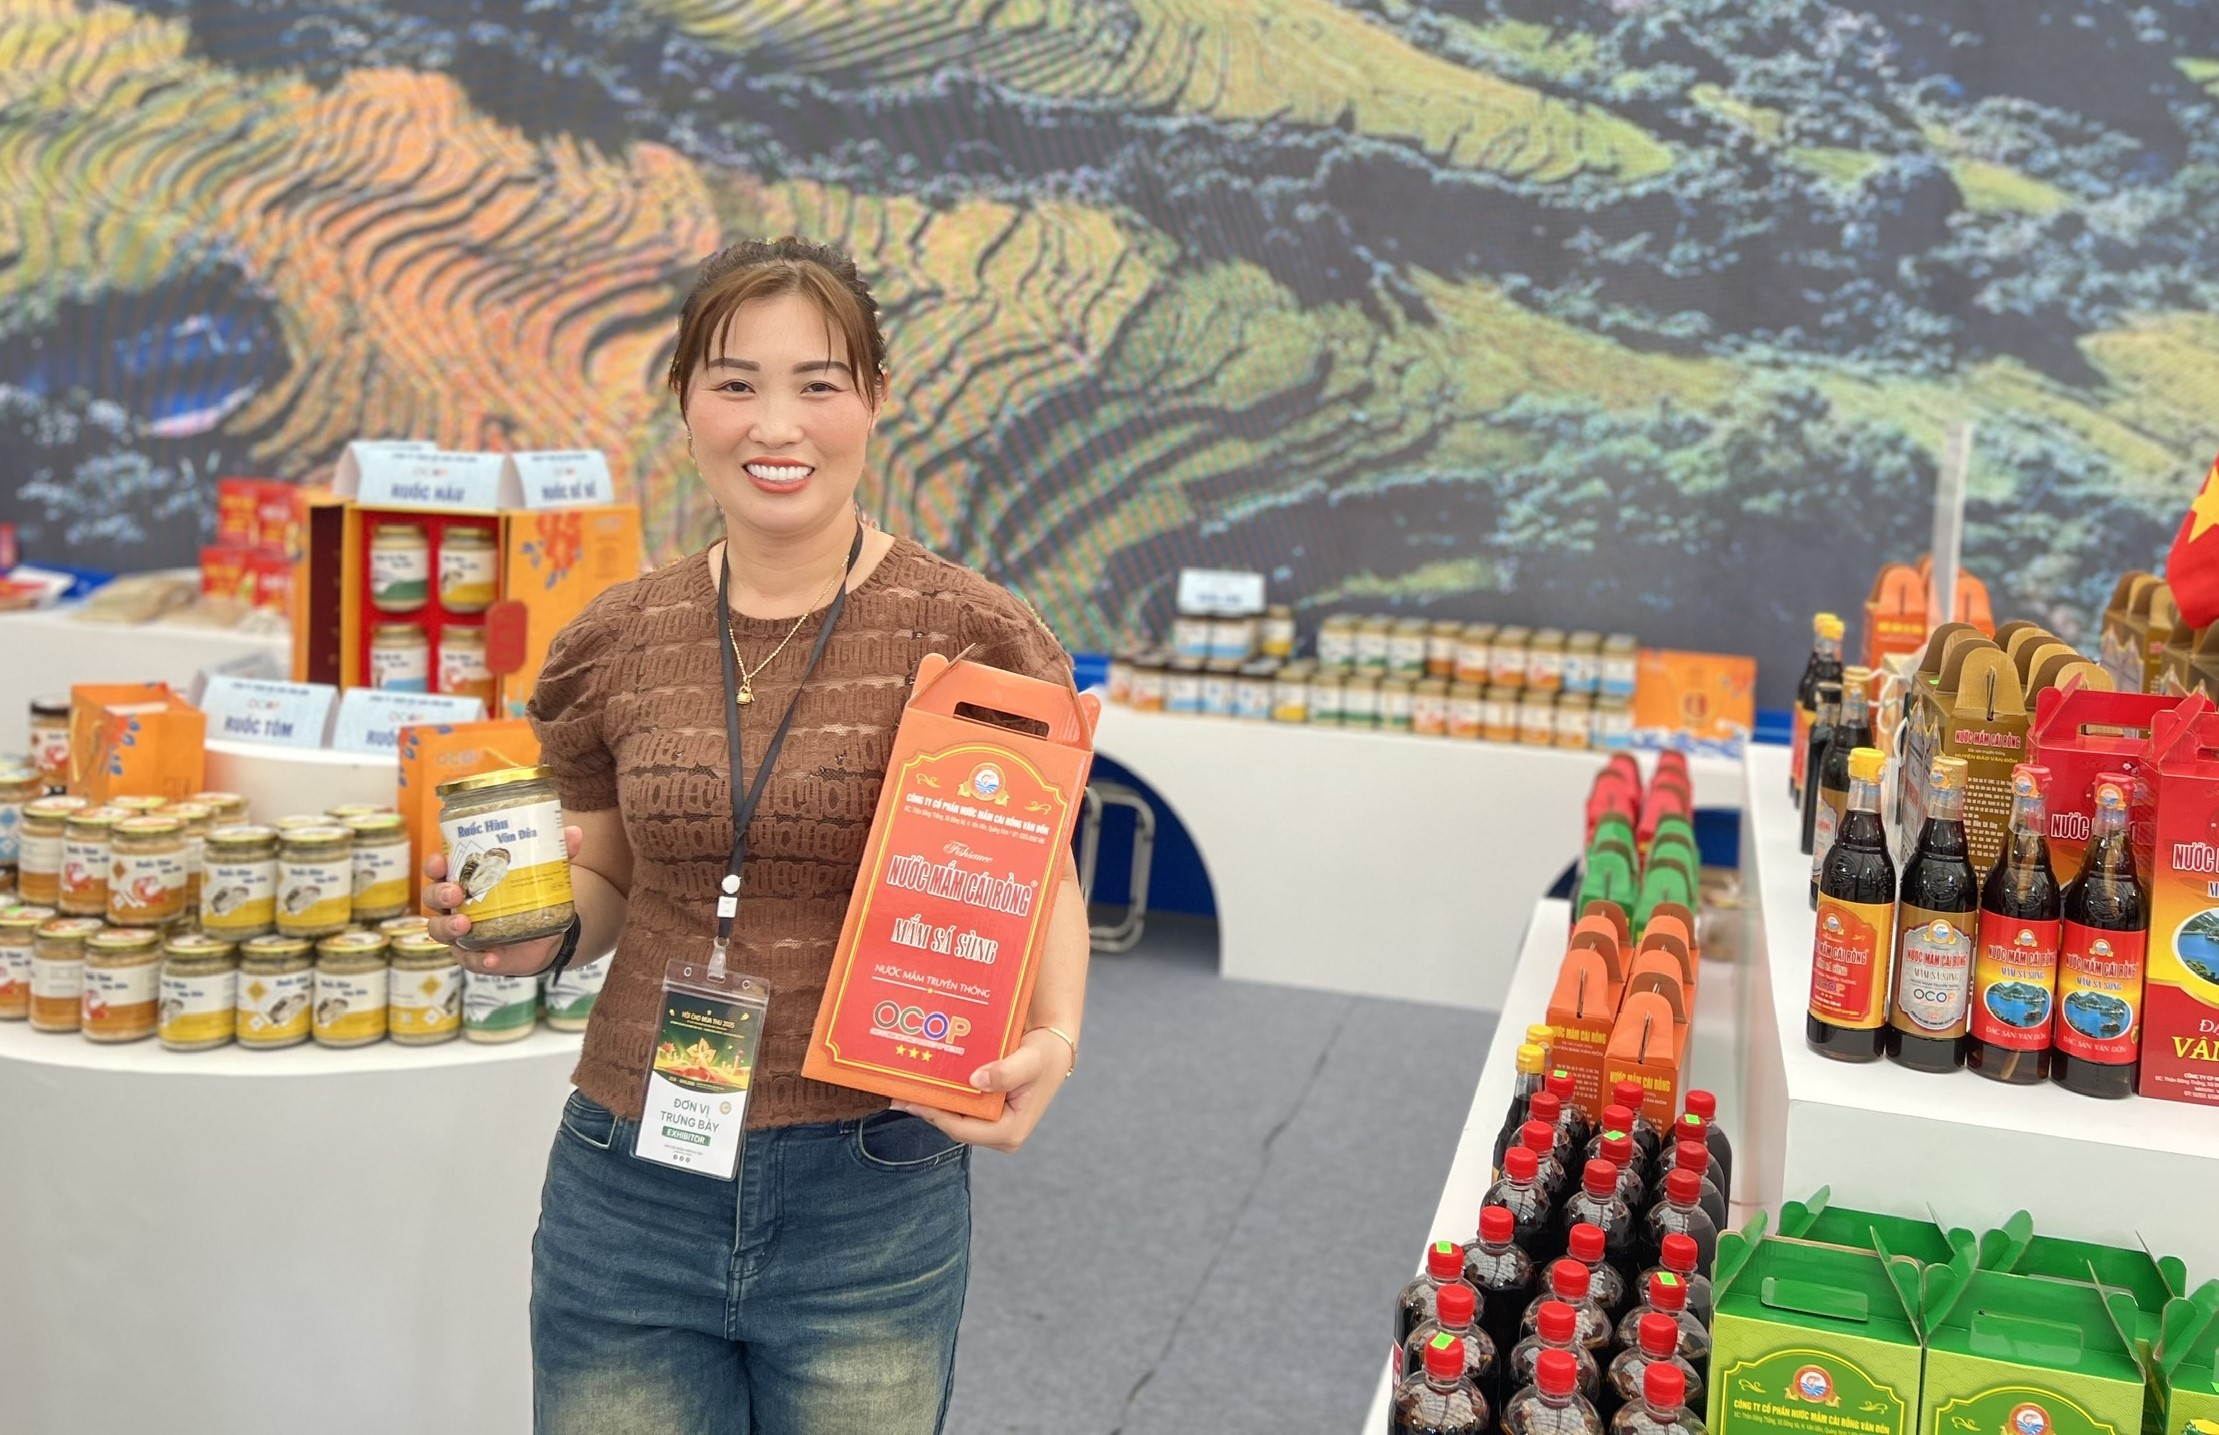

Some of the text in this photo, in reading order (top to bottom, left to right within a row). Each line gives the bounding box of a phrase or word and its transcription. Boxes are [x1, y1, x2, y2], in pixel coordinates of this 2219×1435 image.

[906, 793, 924, 806] CÔNG
[924, 798, 933, 807] TY
[457, 819, 509, 838] Ruốc Hàu
[2050, 812, 2090, 841] NƯỚC
[496, 833, 517, 844] Vân
[2172, 841, 2215, 873] NƯỚC
[886, 855, 1033, 917] NƯỚC MẮM CÁI RỒNG
[891, 914, 999, 965] MẮM SÁ SÙNG
[875, 964, 991, 998] NƯỚC MẮM TRUYỀN THỐNG
[1913, 988, 1956, 1003] OCOP
[873, 1000, 971, 1044] OCOP
[673, 1098, 710, 1118] ĐƠN VỊ
[660, 1110, 720, 1132] TRƯNG BÀY
[667, 1128, 706, 1144] EXHIBITOR
[1733, 1399, 1752, 1411] CÔNG
[1753, 1402, 1762, 1412] TY
[1761, 1401, 1772, 1414] CỔ
